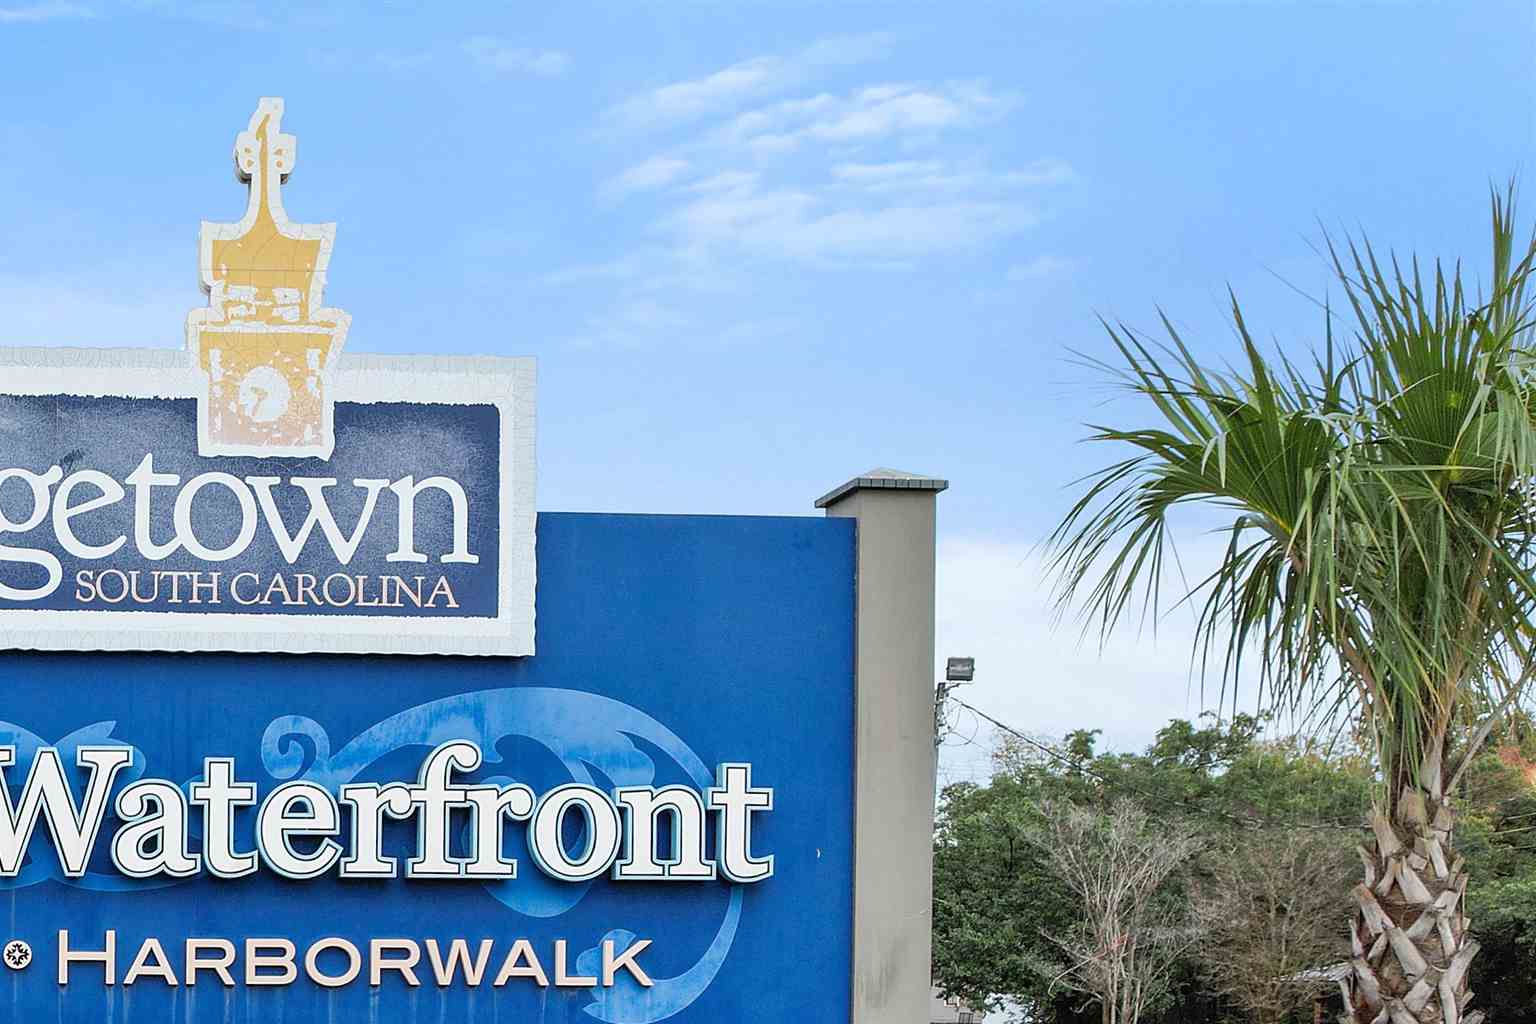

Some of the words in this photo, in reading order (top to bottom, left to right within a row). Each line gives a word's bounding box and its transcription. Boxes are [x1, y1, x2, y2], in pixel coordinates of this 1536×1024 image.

[75, 568, 223, 606] SOUTH
[229, 572, 459, 610] CAROLINA
[57, 929, 654, 989] HARBORWALK
